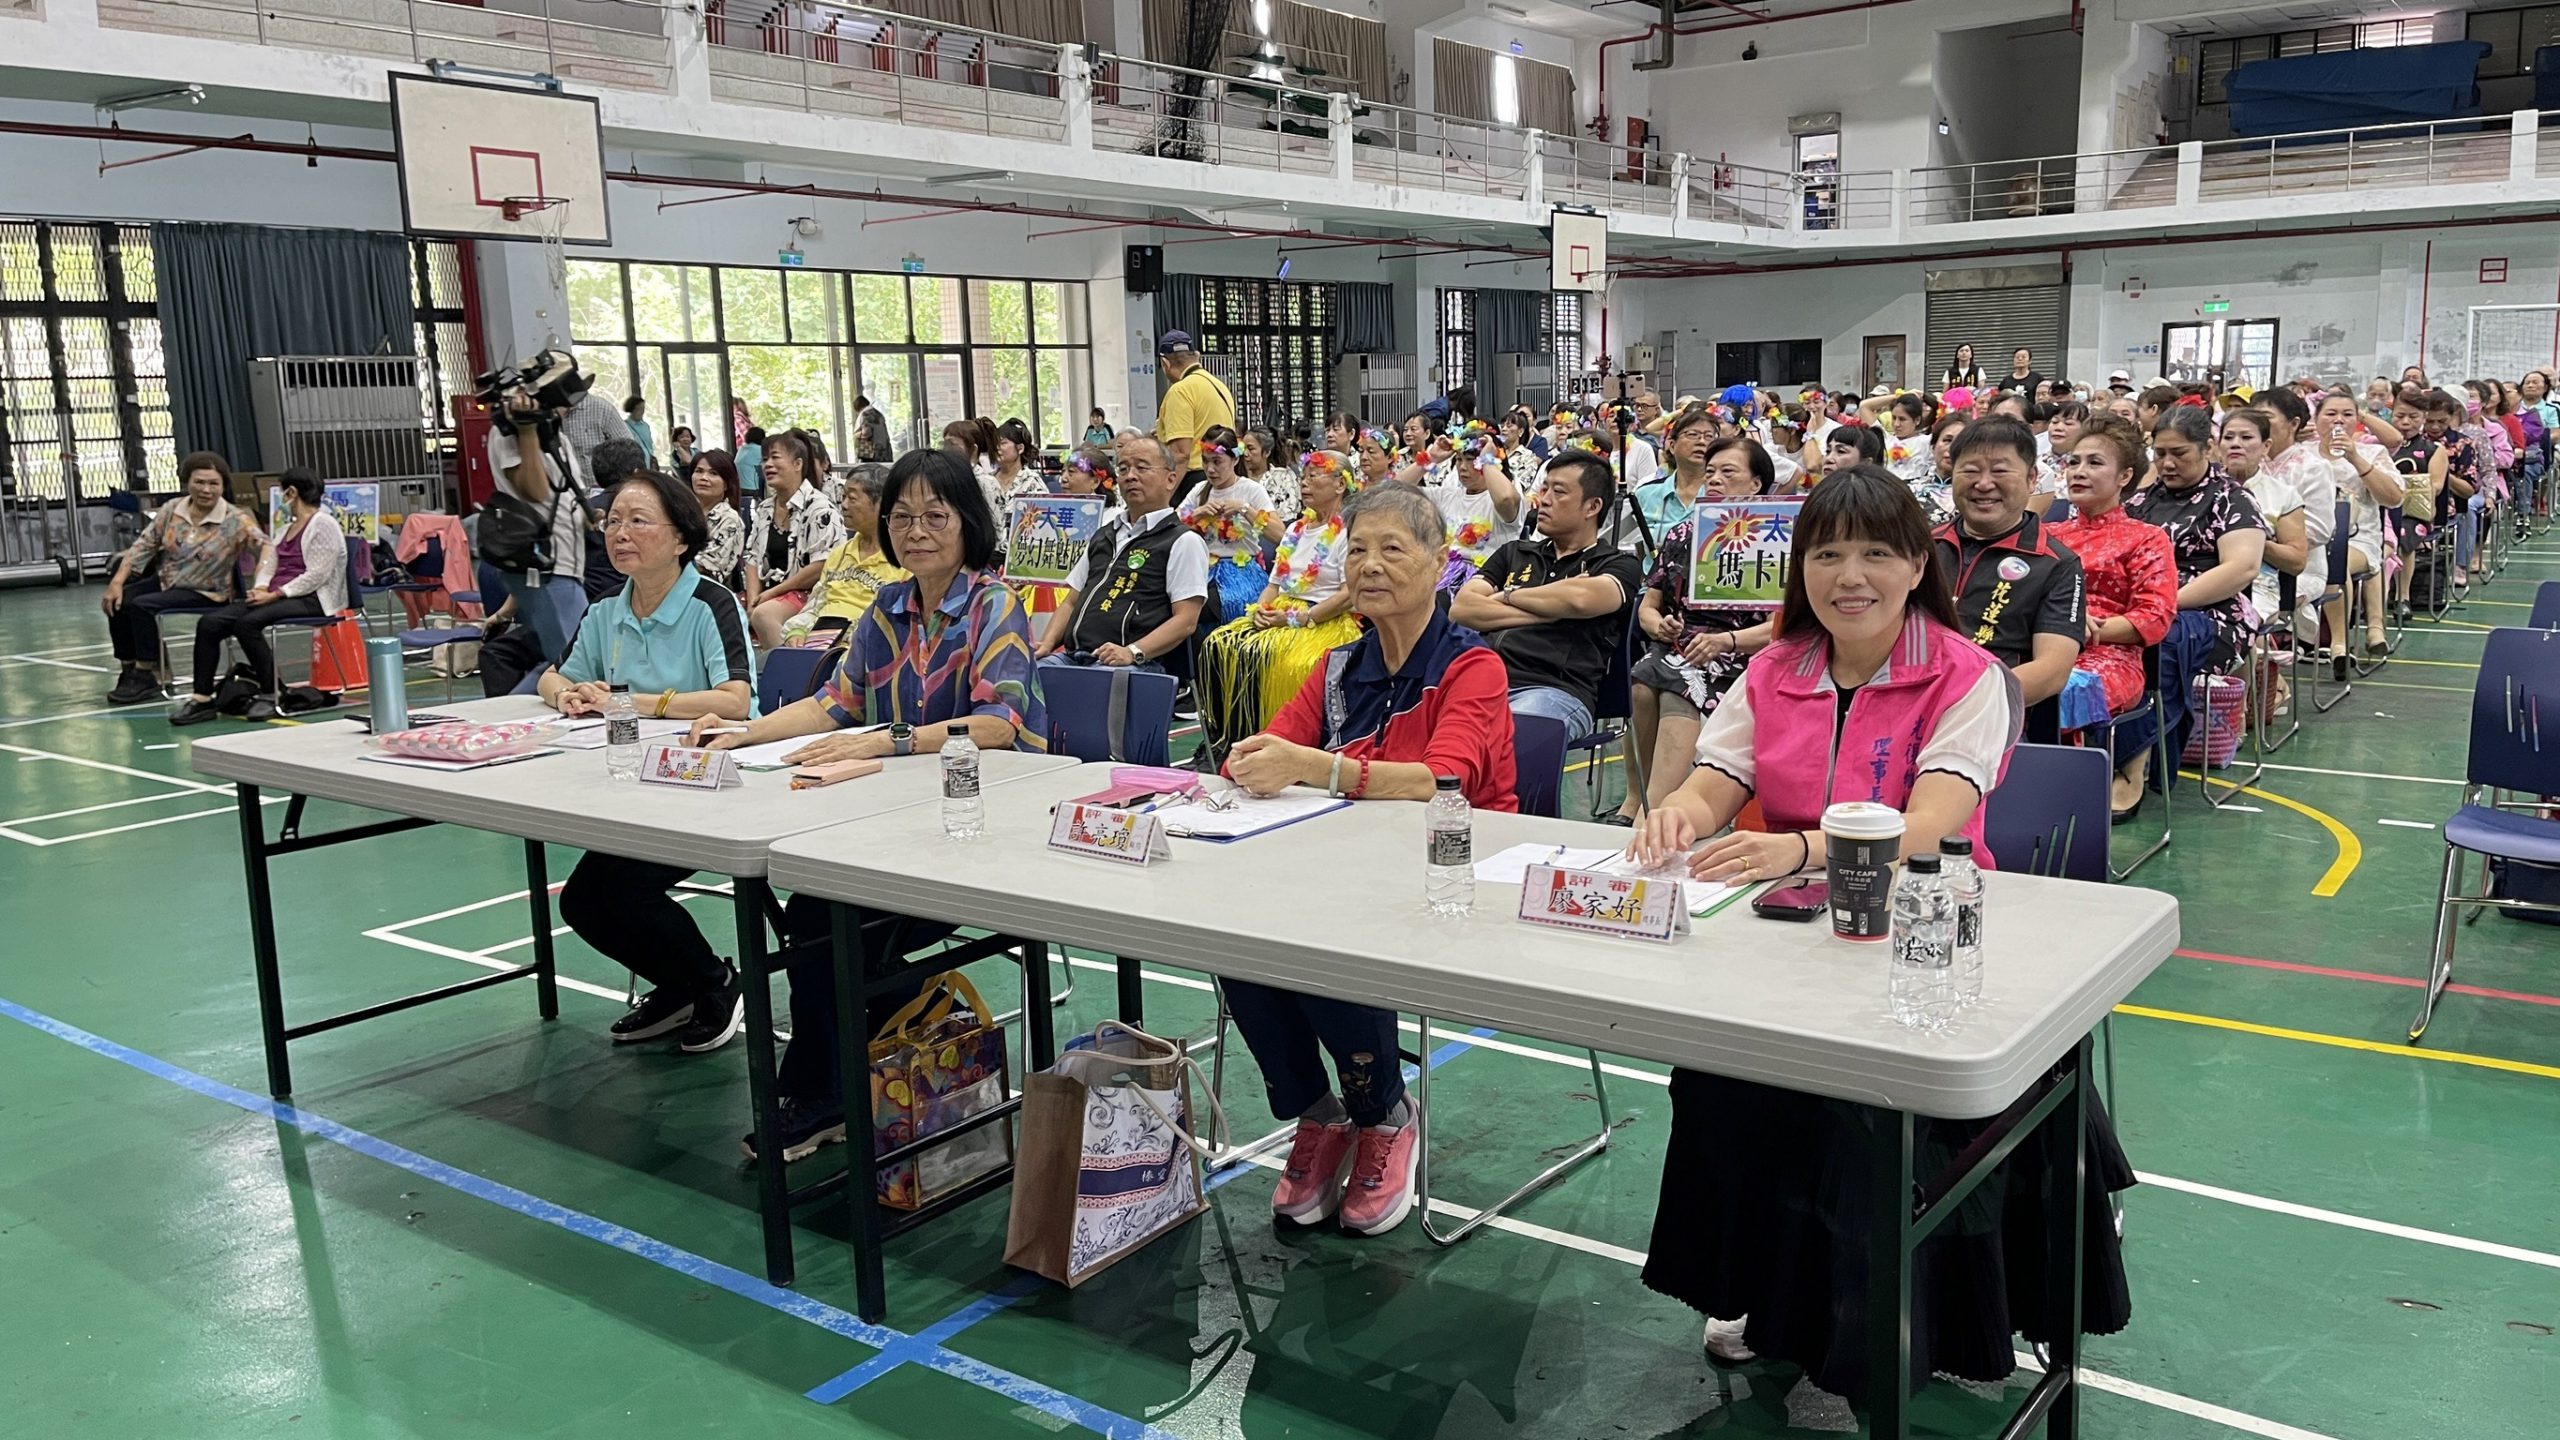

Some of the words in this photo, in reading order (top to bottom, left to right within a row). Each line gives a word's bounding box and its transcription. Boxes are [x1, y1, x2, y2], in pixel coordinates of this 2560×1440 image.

[1038, 507, 1076, 530] 大華
[1973, 581, 2012, 645] 花蓮縣
[1085, 808, 1128, 823] 評審
[1838, 868, 1855, 876] CITY
[1856, 870, 1878, 878] CAFE
[1568, 874, 1633, 892] 評審
